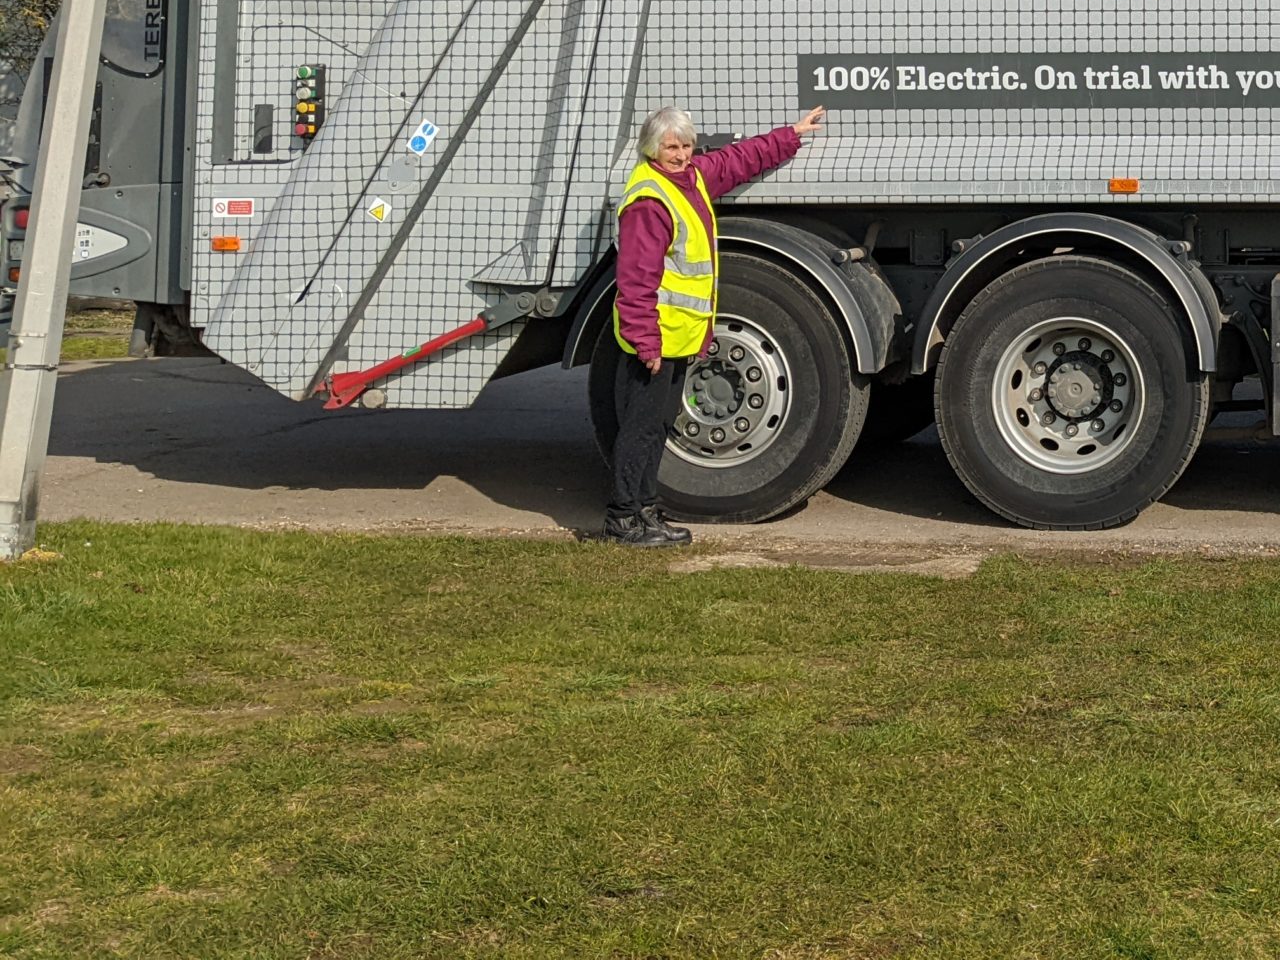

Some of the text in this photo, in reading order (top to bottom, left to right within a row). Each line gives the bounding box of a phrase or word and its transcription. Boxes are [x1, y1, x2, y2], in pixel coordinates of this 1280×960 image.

[812, 65, 891, 91] 100%
[896, 65, 1028, 91] Electric.
[1034, 65, 1077, 90] On
[1083, 64, 1152, 90] trial
[1158, 64, 1230, 89] with
